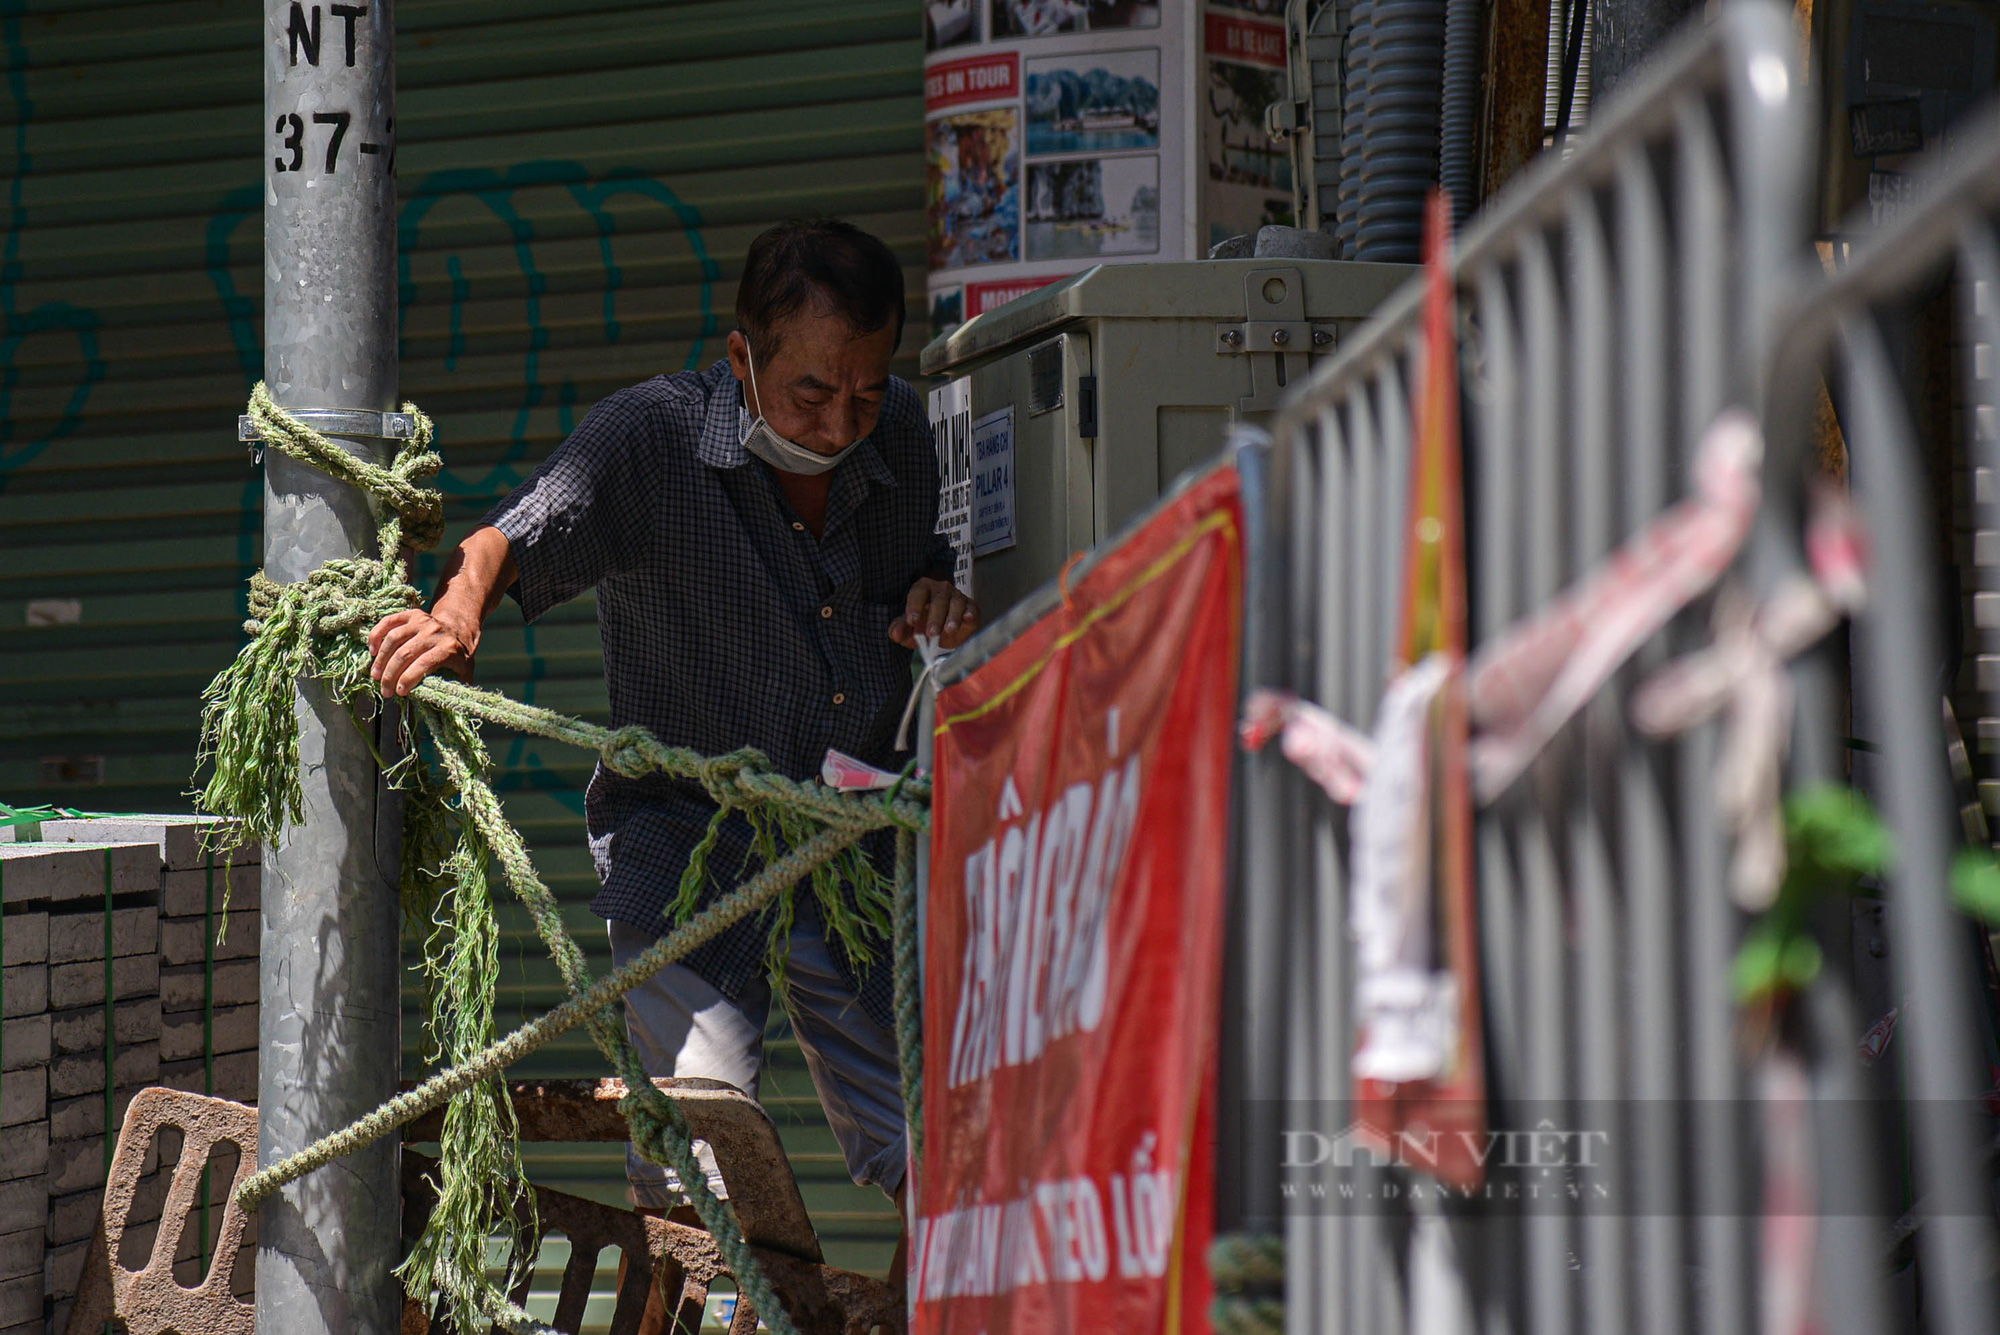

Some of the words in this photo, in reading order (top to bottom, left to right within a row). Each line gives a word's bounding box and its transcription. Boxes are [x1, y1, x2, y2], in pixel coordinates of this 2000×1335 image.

[288, 3, 367, 67] NT
[968, 64, 1009, 90] TOUR
[976, 467, 1003, 499] PILLAR
